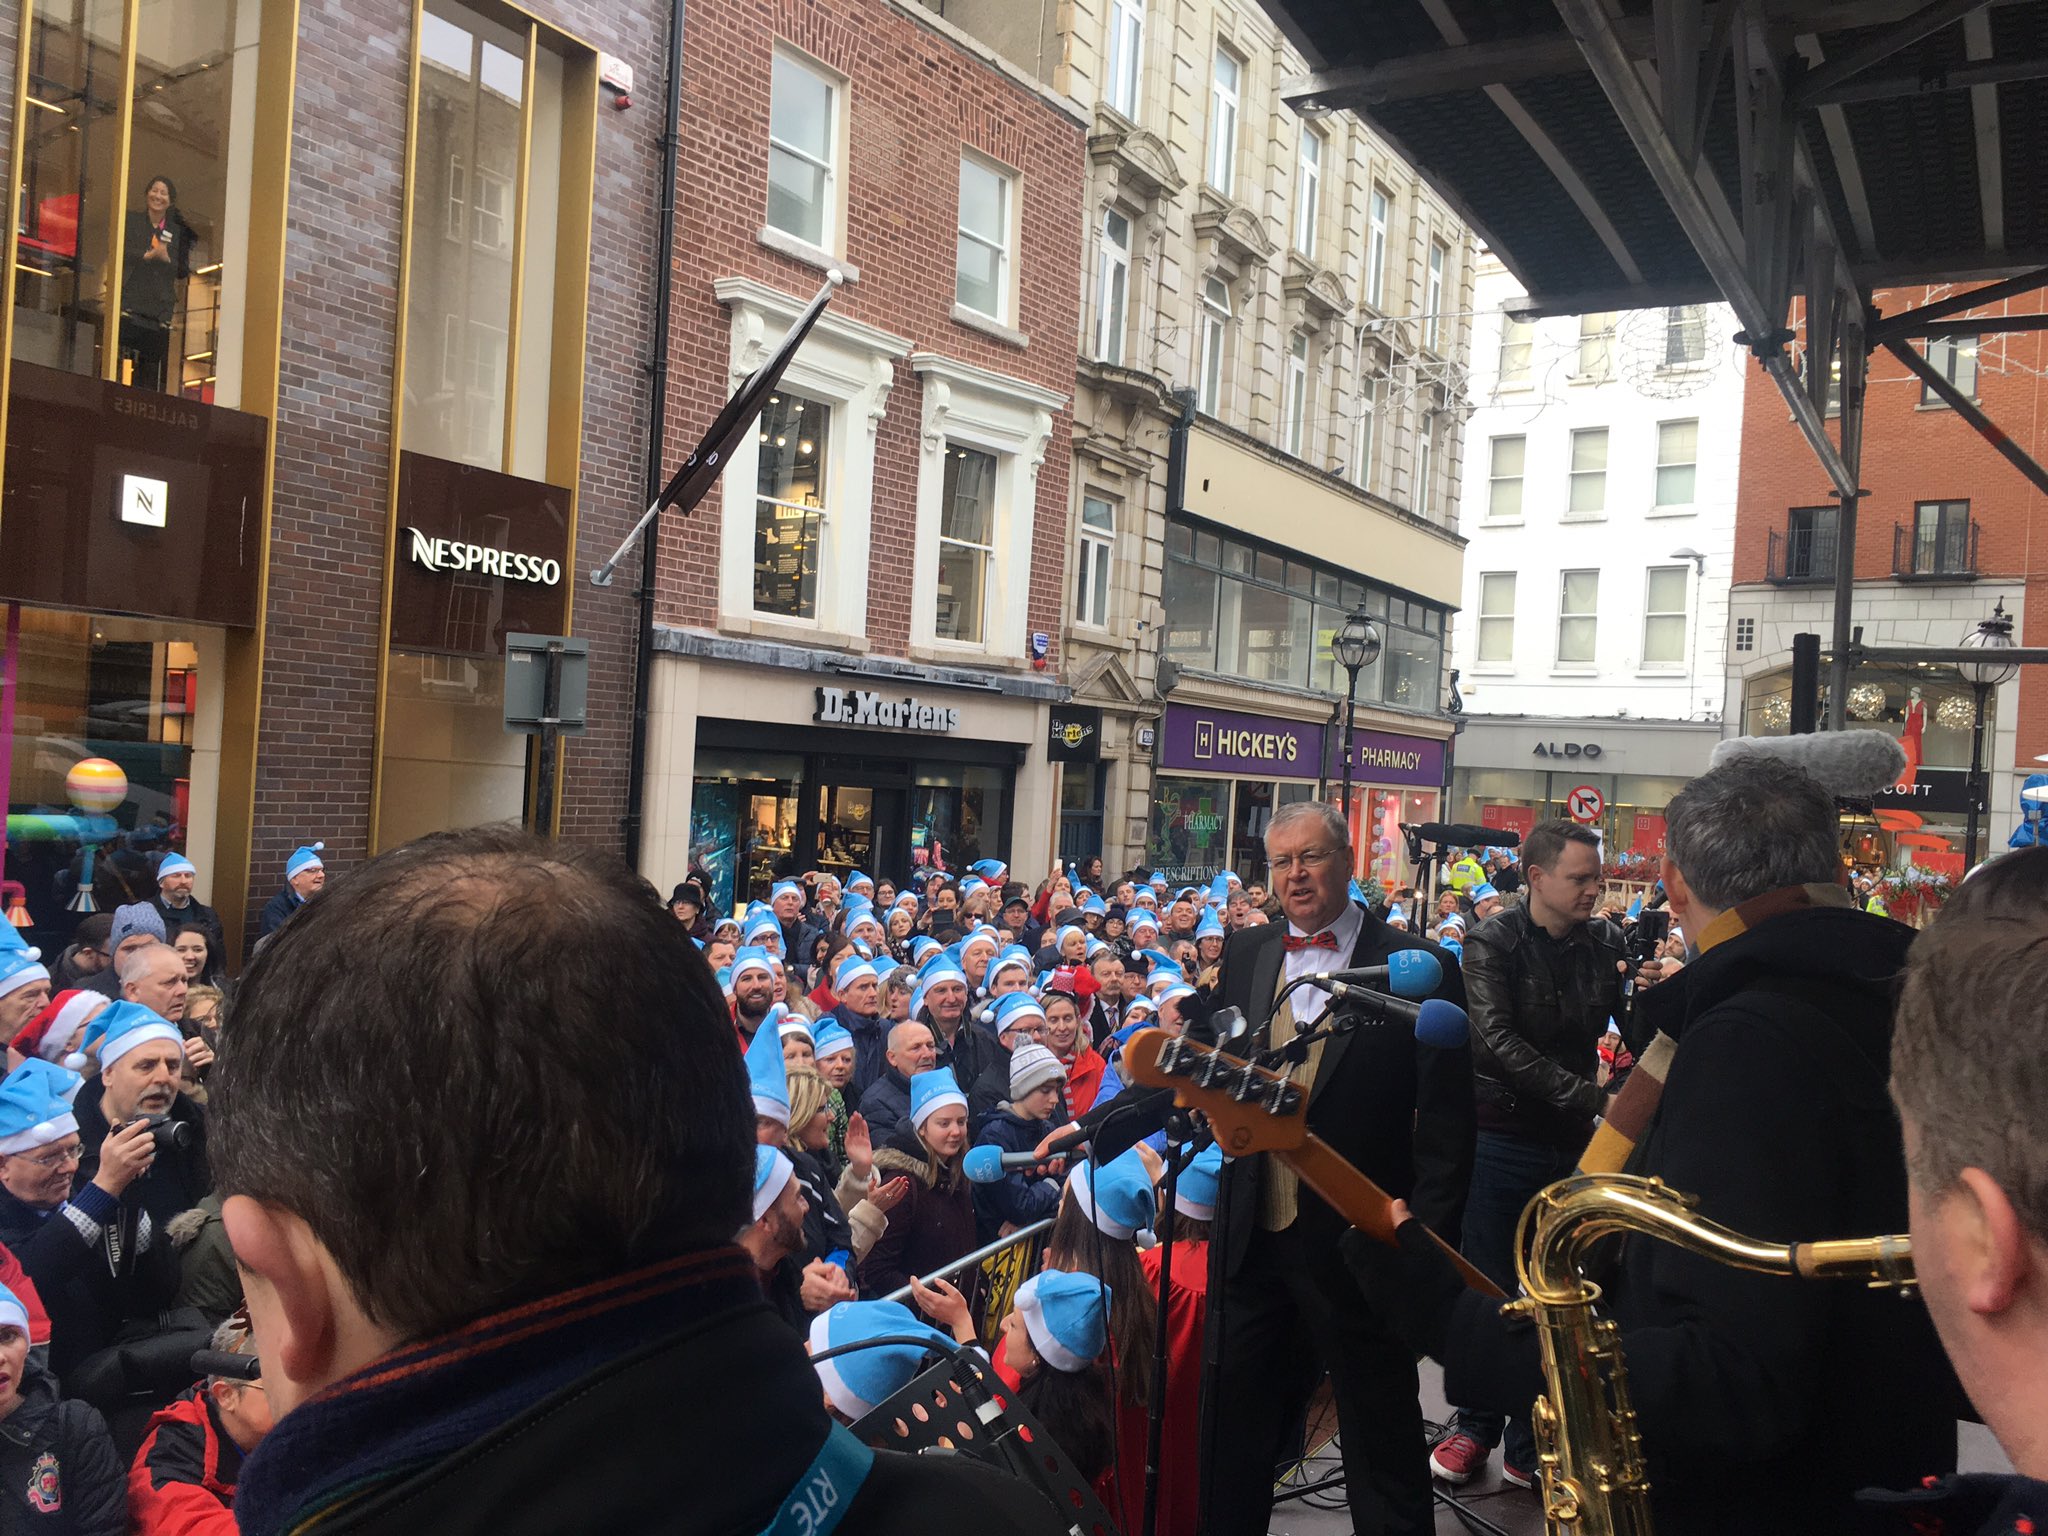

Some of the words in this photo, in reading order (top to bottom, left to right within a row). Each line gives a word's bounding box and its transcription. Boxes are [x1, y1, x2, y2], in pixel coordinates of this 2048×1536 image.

[407, 526, 561, 586] NESPRESSO
[1218, 728, 1298, 762] HICKEY'S
[1533, 742, 1603, 758] ALDO
[1361, 746, 1421, 770] PHARMACY
[1184, 815, 1224, 830] PHARMACY
